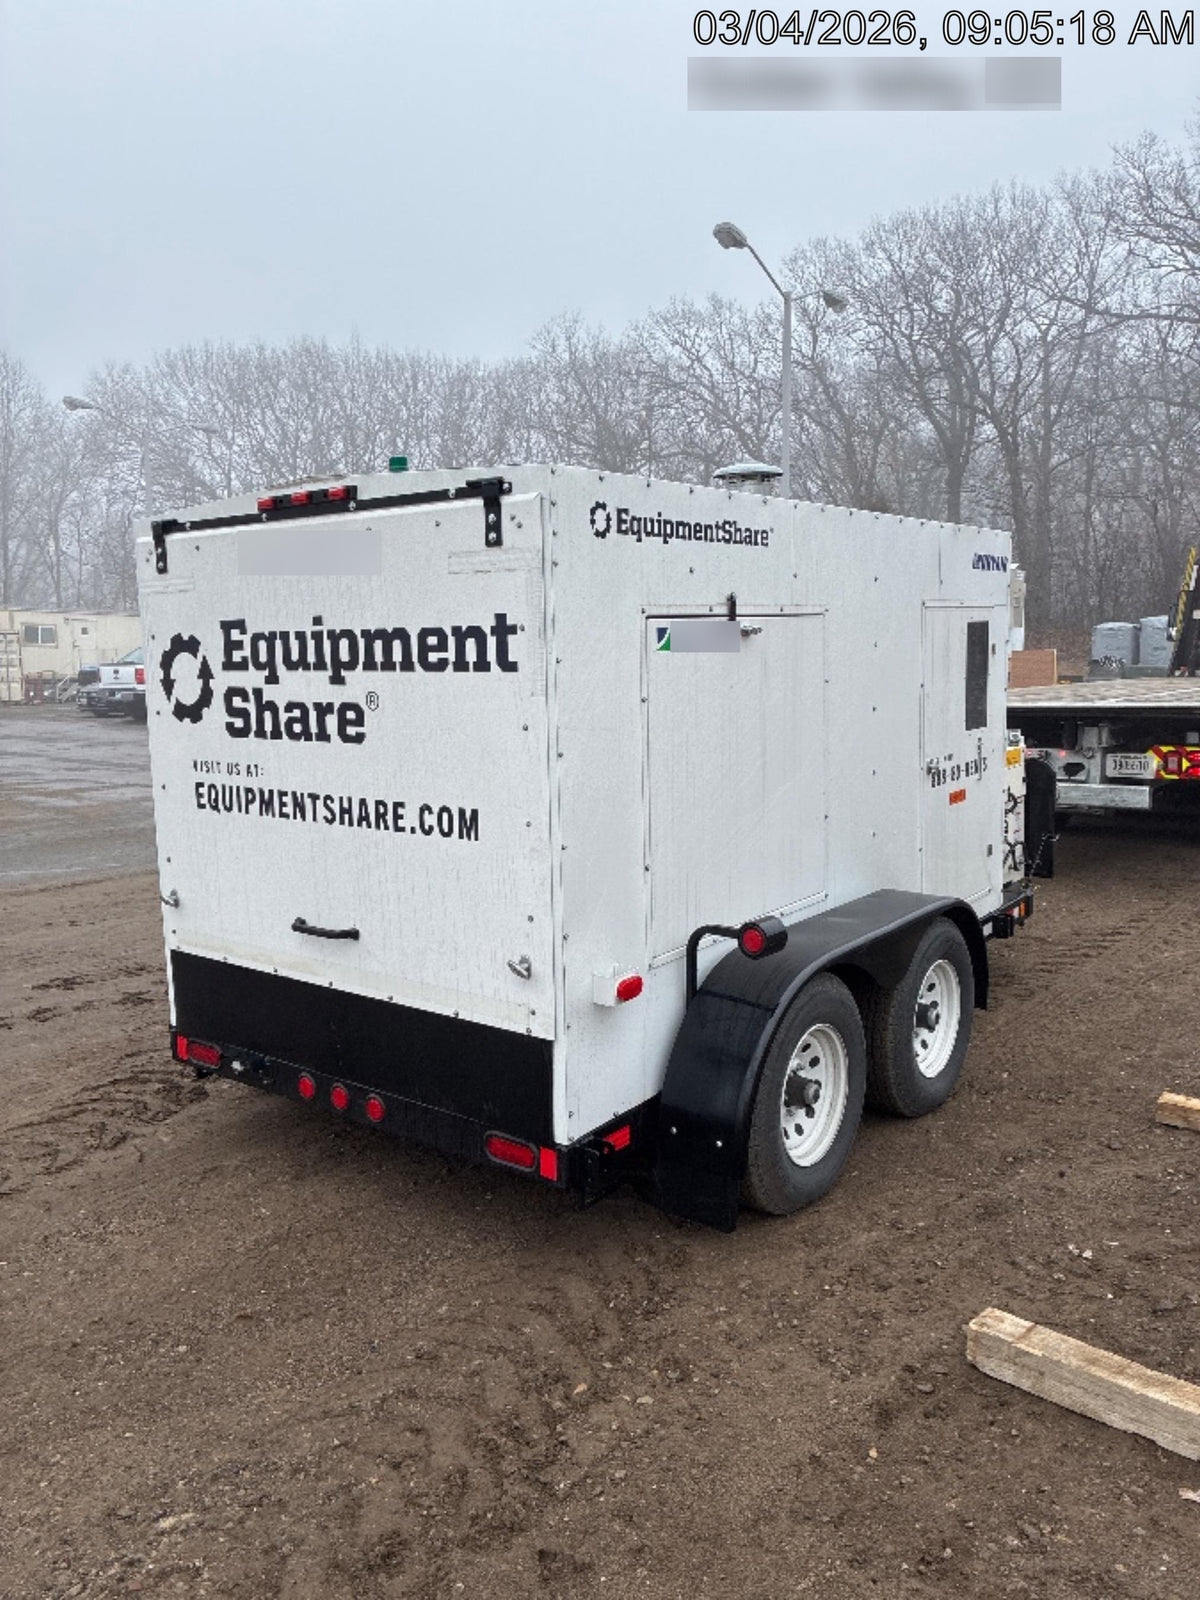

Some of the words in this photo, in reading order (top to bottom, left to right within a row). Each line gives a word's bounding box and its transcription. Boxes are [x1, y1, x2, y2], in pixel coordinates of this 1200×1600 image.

[616, 507, 770, 547] EquipmentShare
[219, 613, 519, 685] Equipment
[192, 760, 221, 774] VISIT
[227, 762, 241, 776] US
[246, 763, 264, 778] AT:
[194, 781, 480, 842] EQUIPMENTSHARE.COM
